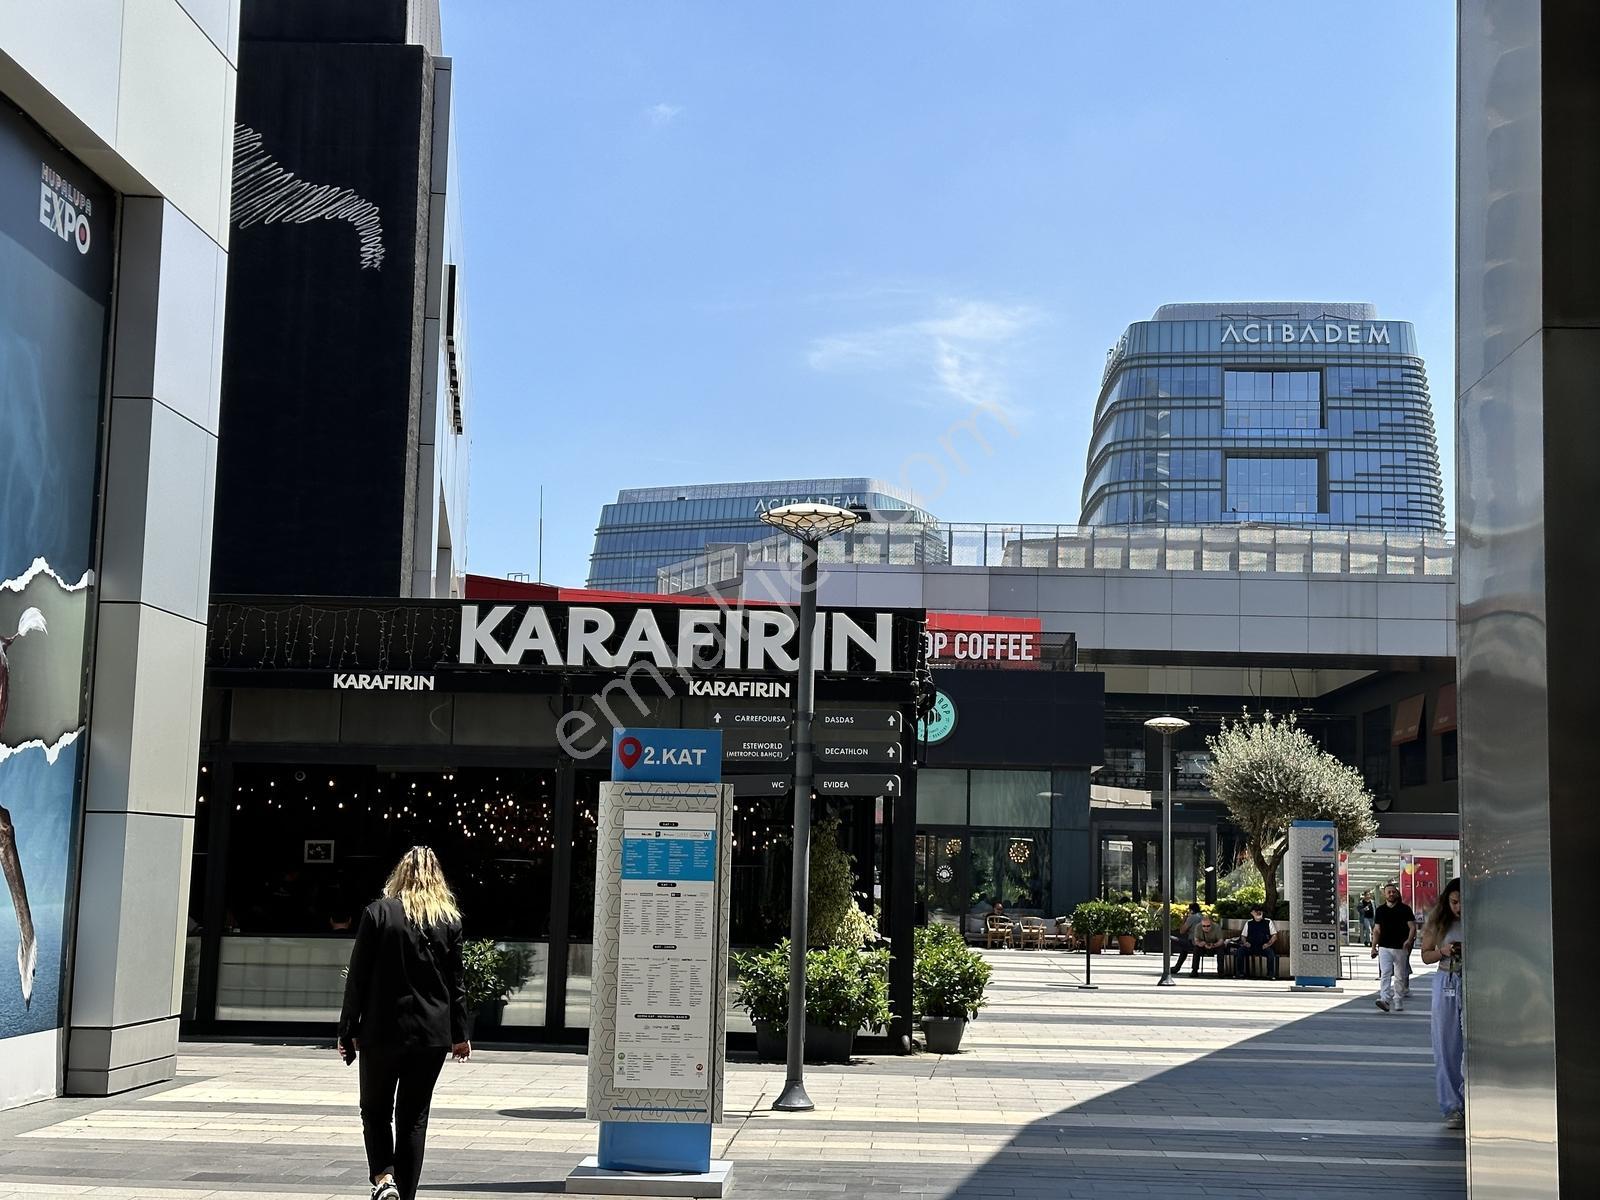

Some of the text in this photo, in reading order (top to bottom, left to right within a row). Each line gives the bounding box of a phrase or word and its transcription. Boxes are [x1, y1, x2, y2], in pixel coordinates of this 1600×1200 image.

[40, 181, 91, 254] EXPO
[1221, 323, 1390, 344] ACIBADEM
[459, 605, 893, 672] KARAFIRIN
[954, 633, 1034, 661] COFFEE
[333, 673, 435, 691] KARAFIRIN
[688, 681, 790, 698] KARAFIRIN
[734, 714, 786, 723] CARREFOURSA
[824, 716, 855, 724] DASDAS
[742, 742, 783, 750] ESTEWORLD
[824, 747, 869, 755] DECATHLON
[643, 746, 707, 766] 2.KAT
[771, 781, 785, 789] WC
[823, 781, 850, 789] EVIDEA
[1322, 834, 1334, 852] 2
